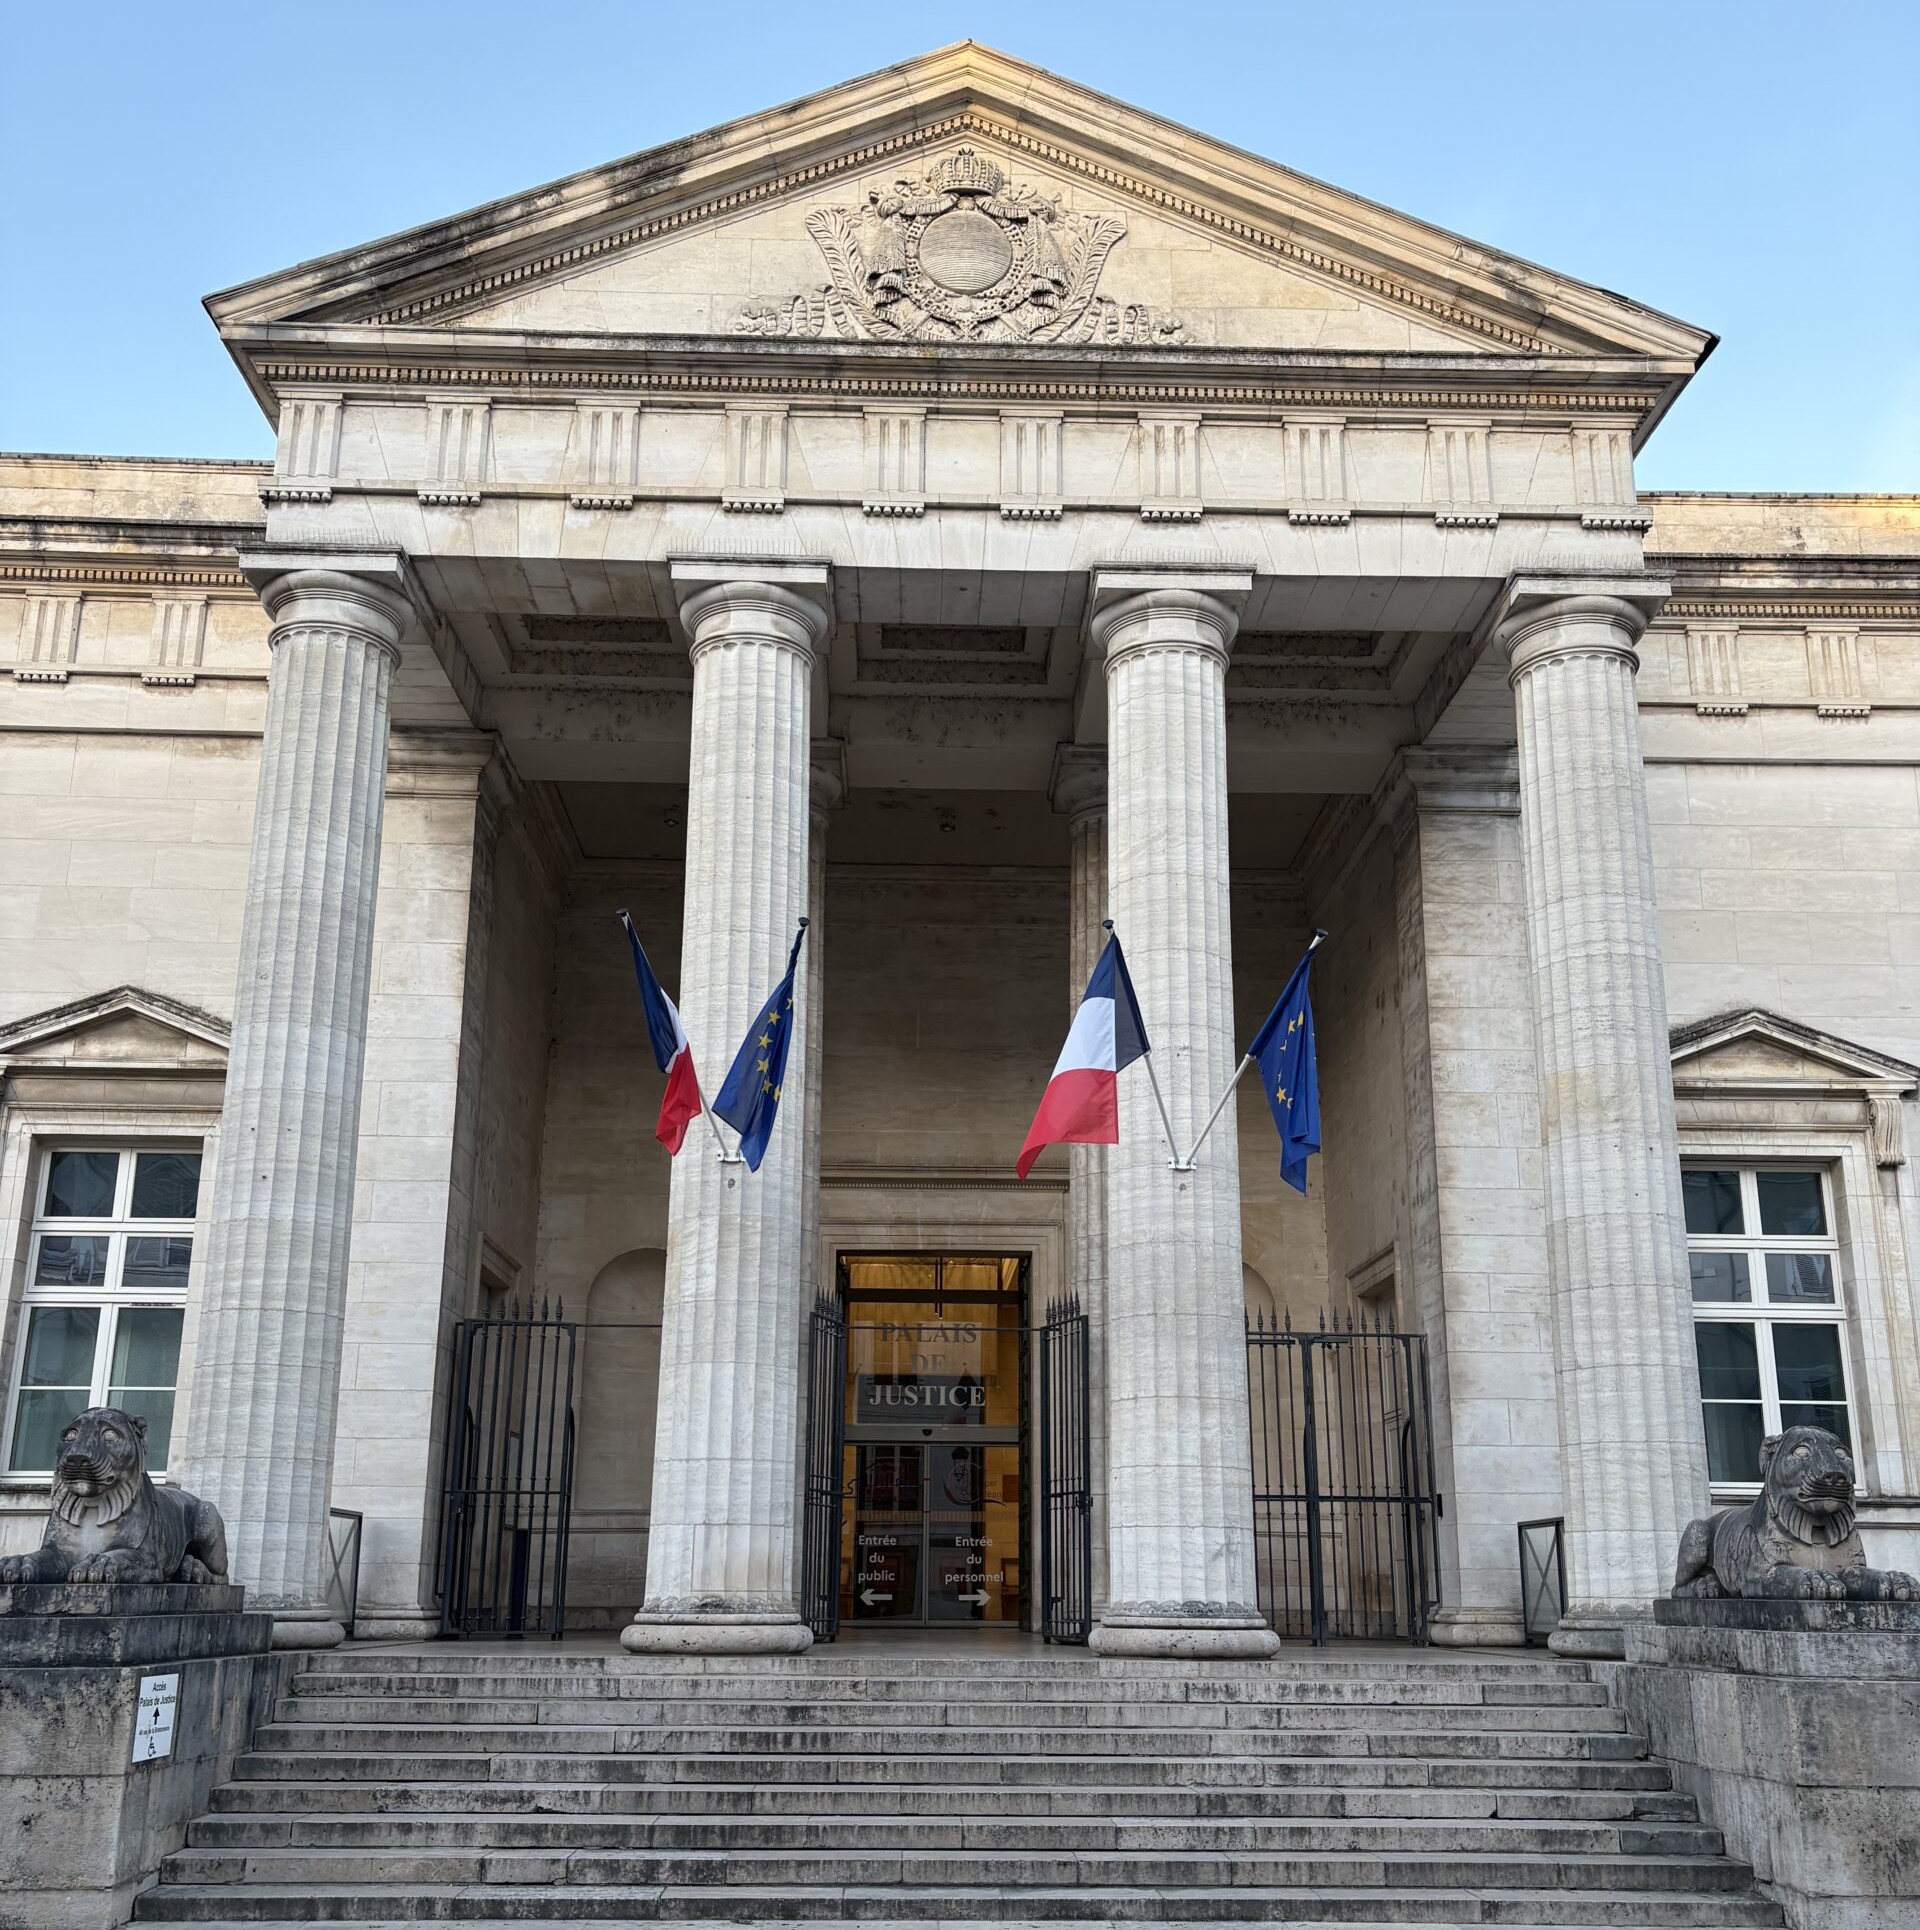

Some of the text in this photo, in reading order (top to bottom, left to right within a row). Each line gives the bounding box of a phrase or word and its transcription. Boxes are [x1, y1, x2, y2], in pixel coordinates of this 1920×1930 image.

[881, 1322, 977, 1343] PALAIS
[911, 1354, 946, 1373] DE
[869, 1385, 986, 1407] JUSTICE
[858, 1535, 897, 1546] Entrée
[955, 1536, 993, 1547] Entrée
[869, 1552, 885, 1563] du
[966, 1554, 982, 1565] du
[858, 1570, 895, 1583] public
[944, 1571, 1004, 1584] personnel
[152, 1681, 167, 1692] Accès
[139, 1693, 176, 1707] Palais de Justice
